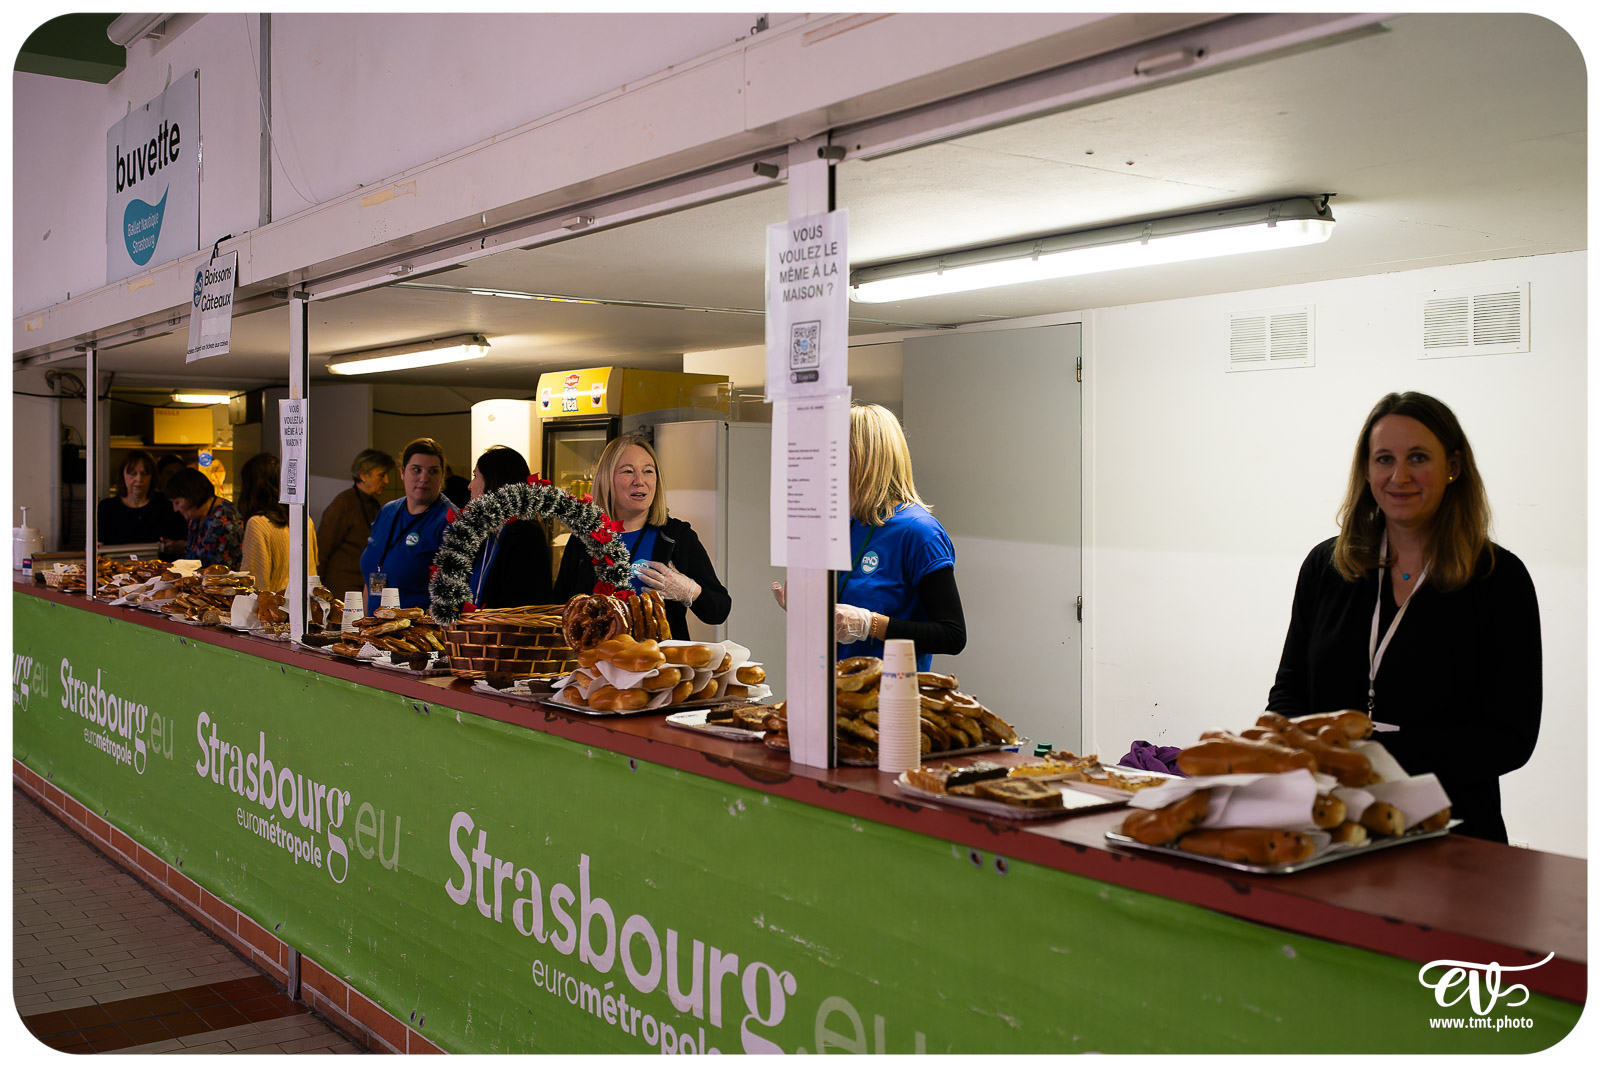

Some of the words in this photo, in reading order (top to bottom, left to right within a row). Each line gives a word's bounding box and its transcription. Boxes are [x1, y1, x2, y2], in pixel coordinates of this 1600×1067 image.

[116, 119, 181, 194] buvette
[128, 220, 141, 237] Ballet
[141, 212, 159, 230] Nautique
[793, 224, 823, 242] VOUS
[132, 234, 155, 254] Strasbourg
[779, 245, 821, 265] VOULEZ
[824, 241, 838, 257] LE
[204, 267, 232, 287] Boissons
[779, 266, 809, 284] MÊME
[812, 262, 820, 279] À
[823, 262, 838, 276] LA
[201, 292, 232, 312] Gâteaux
[782, 284, 824, 303] MAISON
[827, 282, 834, 296] ?
[289, 404, 299, 413] VOUS
[284, 416, 298, 424] VOULEZ
[284, 425, 295, 435] MÊME
[299, 427, 304, 435] LA
[285, 438, 299, 447] MAISON
[60, 657, 173, 775] Strasbourg.eu
[83, 727, 132, 766] eurométropole
[195, 711, 401, 884] Strasbourg.eu
[236, 806, 322, 869] eurométropole
[532, 959, 722, 1054] eurométropol
